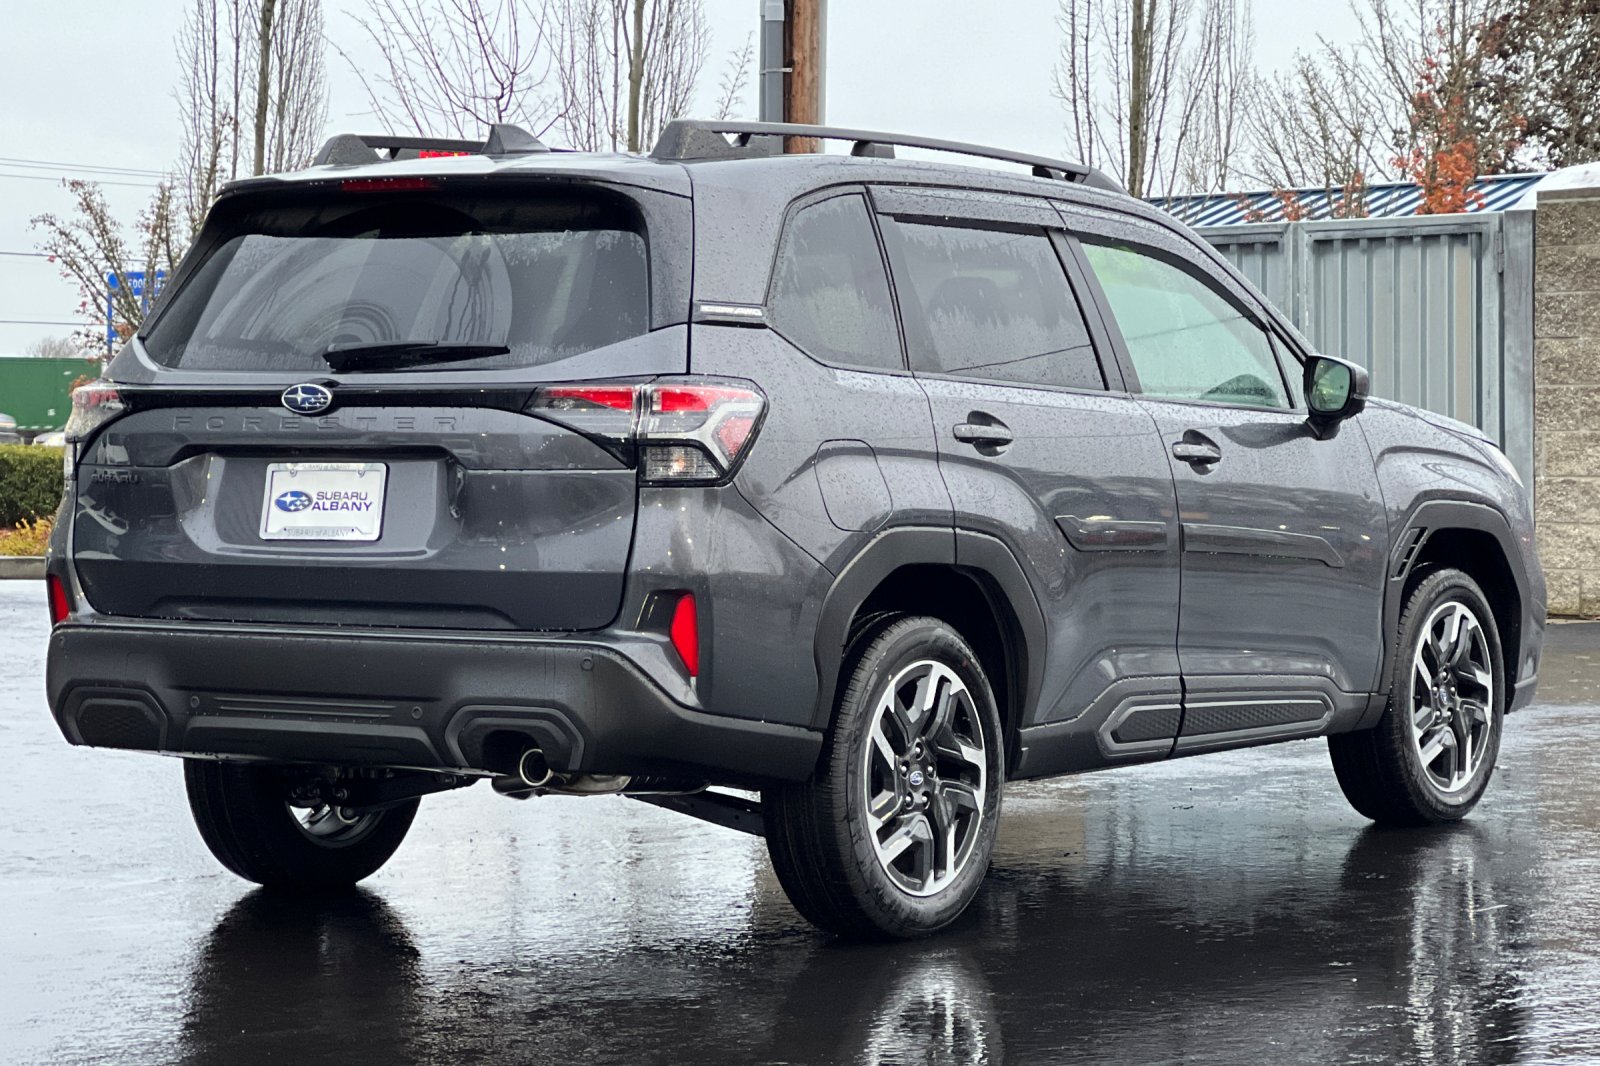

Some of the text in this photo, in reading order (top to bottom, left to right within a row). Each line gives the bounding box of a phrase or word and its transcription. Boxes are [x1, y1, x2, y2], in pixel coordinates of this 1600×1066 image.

[172, 416, 457, 431] FORESTER
[90, 473, 139, 484] SUBARU
[316, 491, 368, 501] SUBARU
[311, 501, 373, 511] ALBANY
